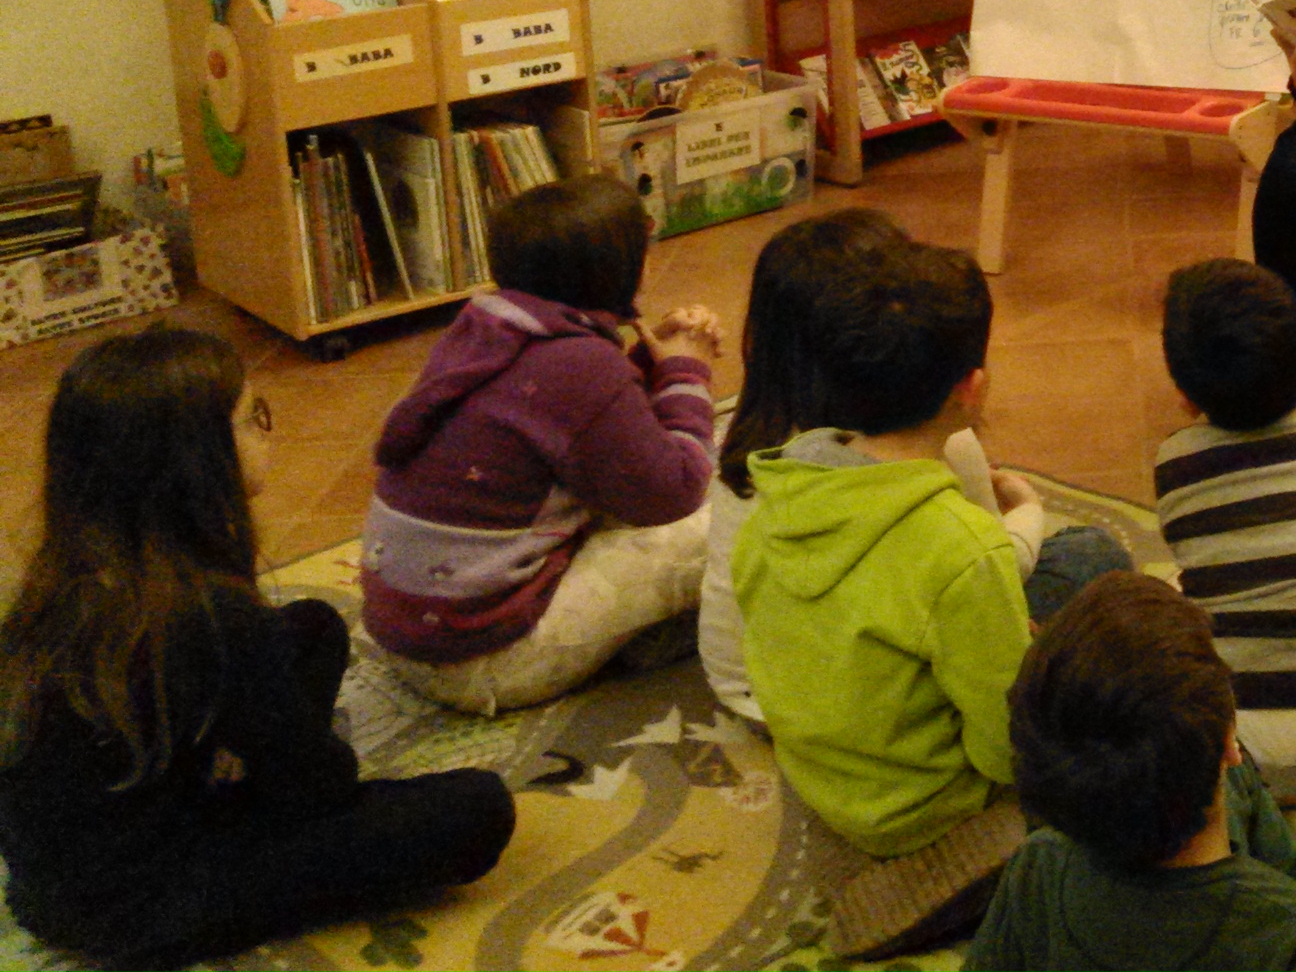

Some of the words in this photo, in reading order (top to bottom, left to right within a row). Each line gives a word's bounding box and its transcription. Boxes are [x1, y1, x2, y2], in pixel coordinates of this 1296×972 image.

[474, 34, 484, 45] B
[511, 23, 554, 39] BABA
[306, 61, 317, 73] B
[348, 47, 395, 65] BABA
[481, 74, 491, 84] B
[519, 61, 563, 79] NORD
